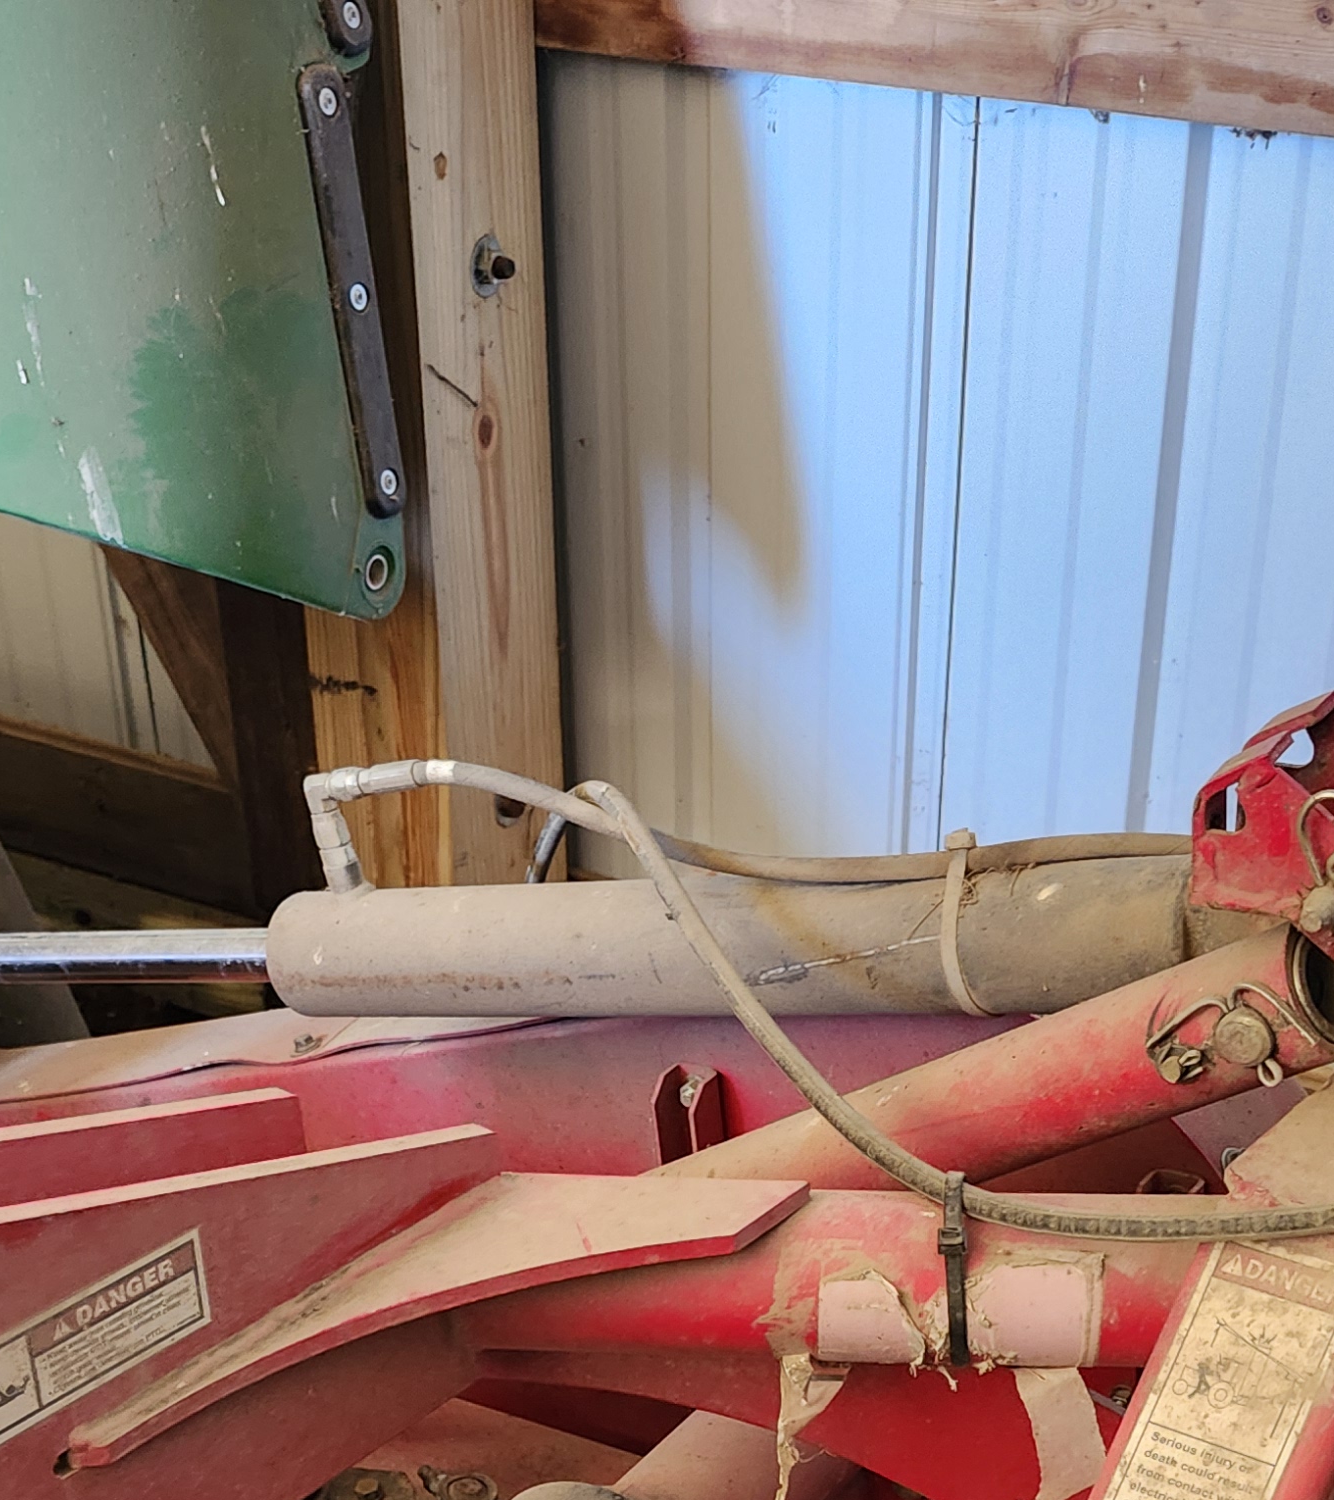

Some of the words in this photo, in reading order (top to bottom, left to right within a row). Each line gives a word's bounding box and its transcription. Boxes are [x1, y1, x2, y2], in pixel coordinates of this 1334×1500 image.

[74, 1256, 174, 1328] DANGER
[1142, 1447, 1179, 1467] death
[1180, 1461, 1216, 1481] could
[1216, 1474, 1254, 1494] result
[1149, 1431, 1198, 1455] Serious
[1197, 1448, 1236, 1472] injury
[1135, 1464, 1166, 1482] from
[1166, 1475, 1215, 1500] contact
